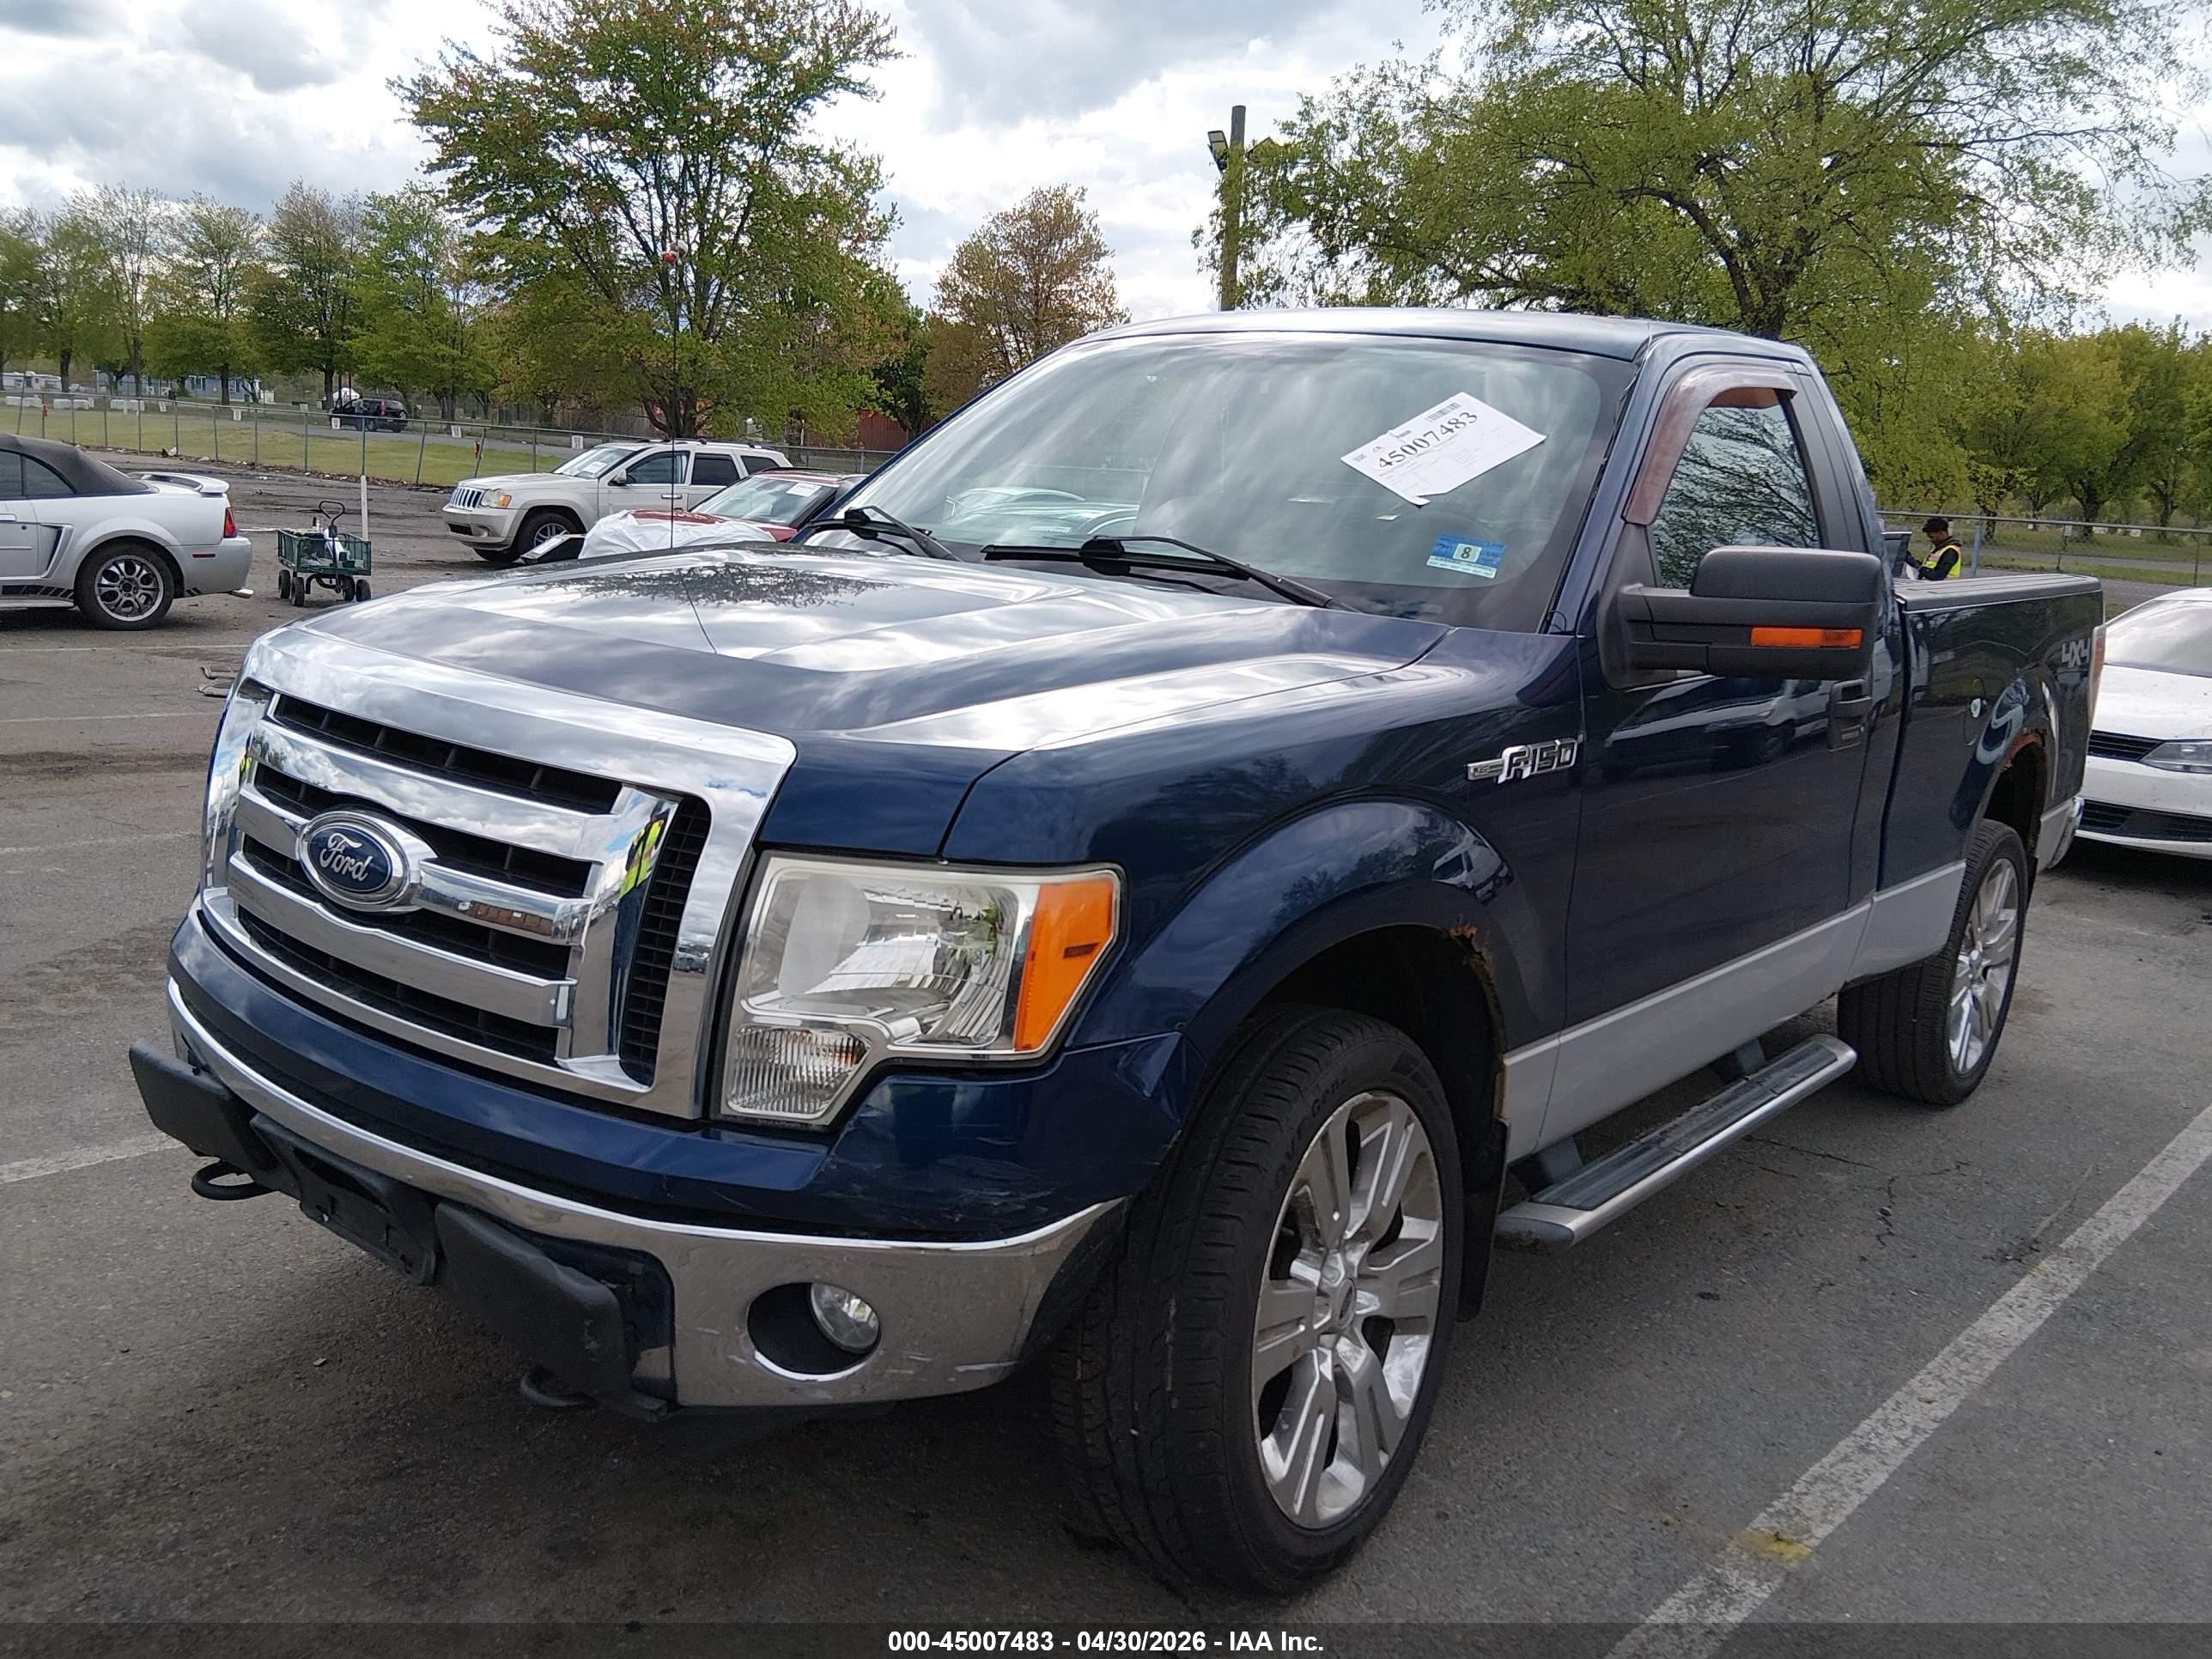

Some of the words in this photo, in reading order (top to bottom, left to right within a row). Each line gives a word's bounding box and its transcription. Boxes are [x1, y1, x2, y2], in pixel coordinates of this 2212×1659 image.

[1379, 412, 1477, 468] 45007483
[1461, 546, 1472, 559] 8
[319, 833, 374, 882] Ford
